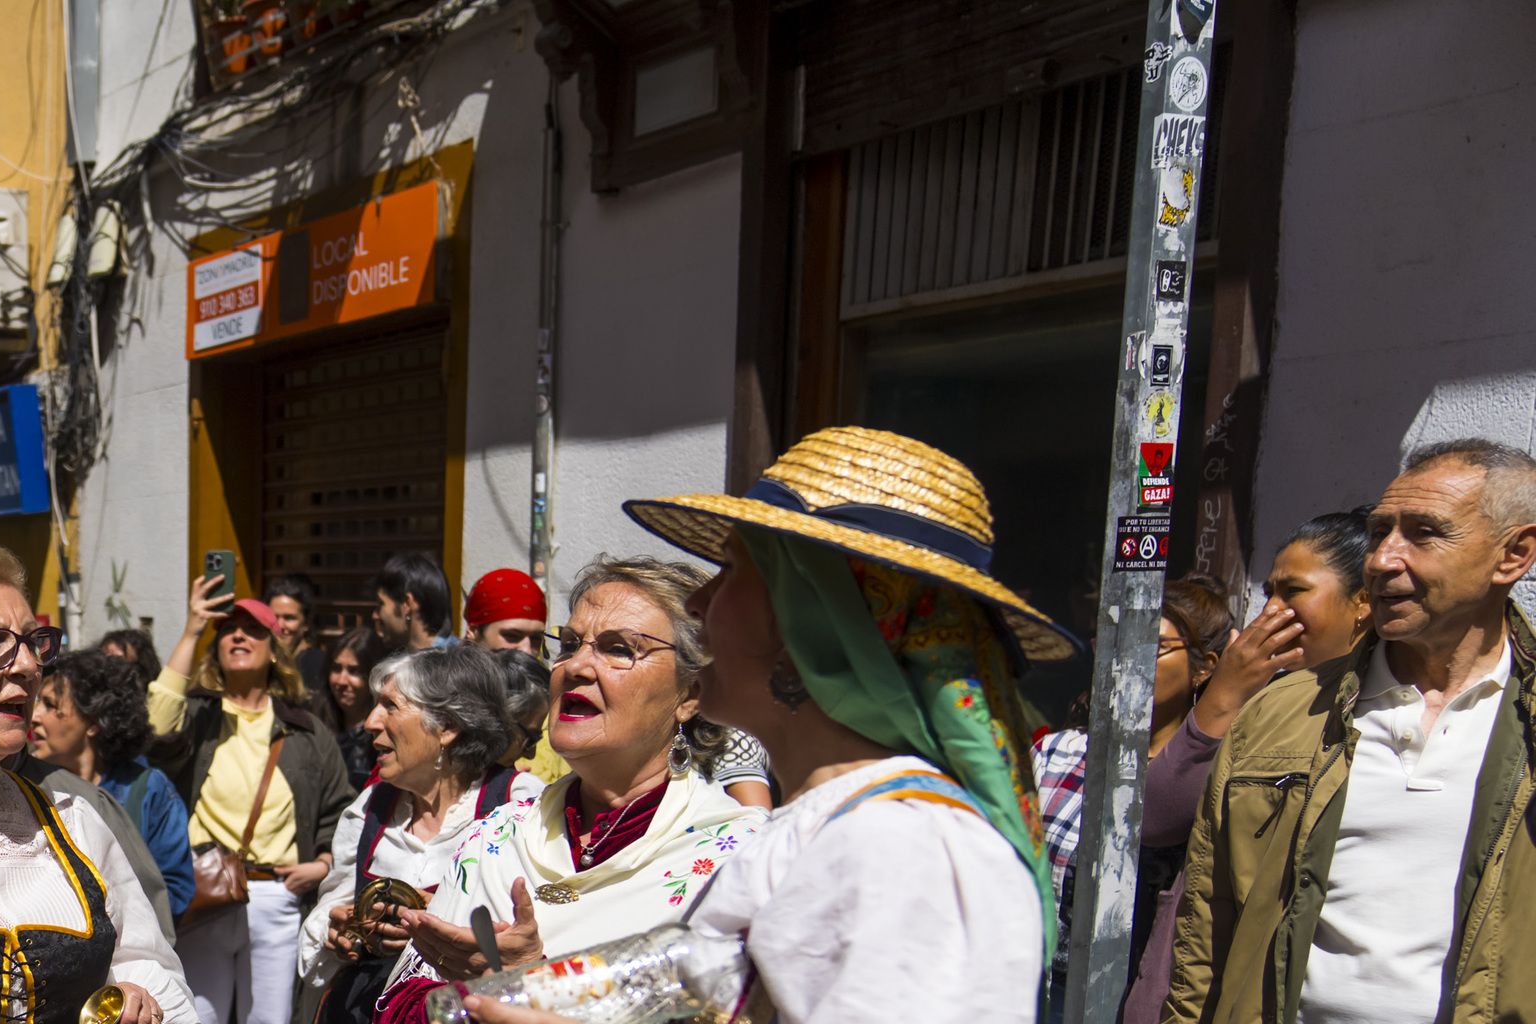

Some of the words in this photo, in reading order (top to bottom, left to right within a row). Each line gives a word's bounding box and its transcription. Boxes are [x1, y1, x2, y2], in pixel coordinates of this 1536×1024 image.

[313, 231, 368, 269] LOCAL
[313, 256, 409, 305] DISPONIBLE
[1142, 477, 1170, 486] DEFIENDE
[1144, 487, 1170, 501] GAZA!
